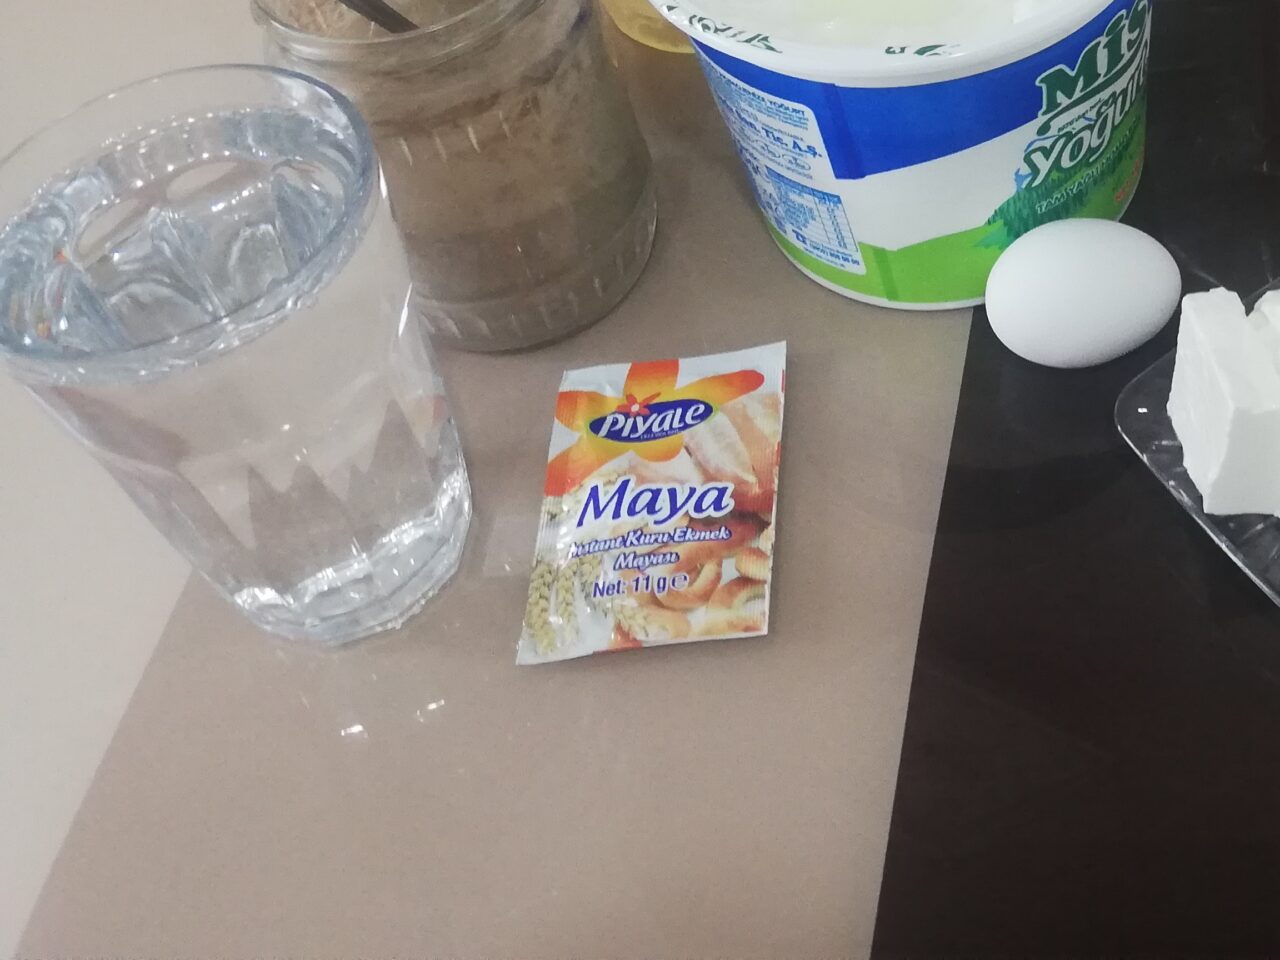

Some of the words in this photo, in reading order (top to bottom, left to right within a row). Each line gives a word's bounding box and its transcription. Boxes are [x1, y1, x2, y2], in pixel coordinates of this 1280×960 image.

[598, 403, 706, 439] Piyale
[576, 478, 730, 528] Maya
[625, 529, 671, 548] Kuru
[673, 525, 732, 543] Ekmek
[592, 578, 625, 598] Net:
